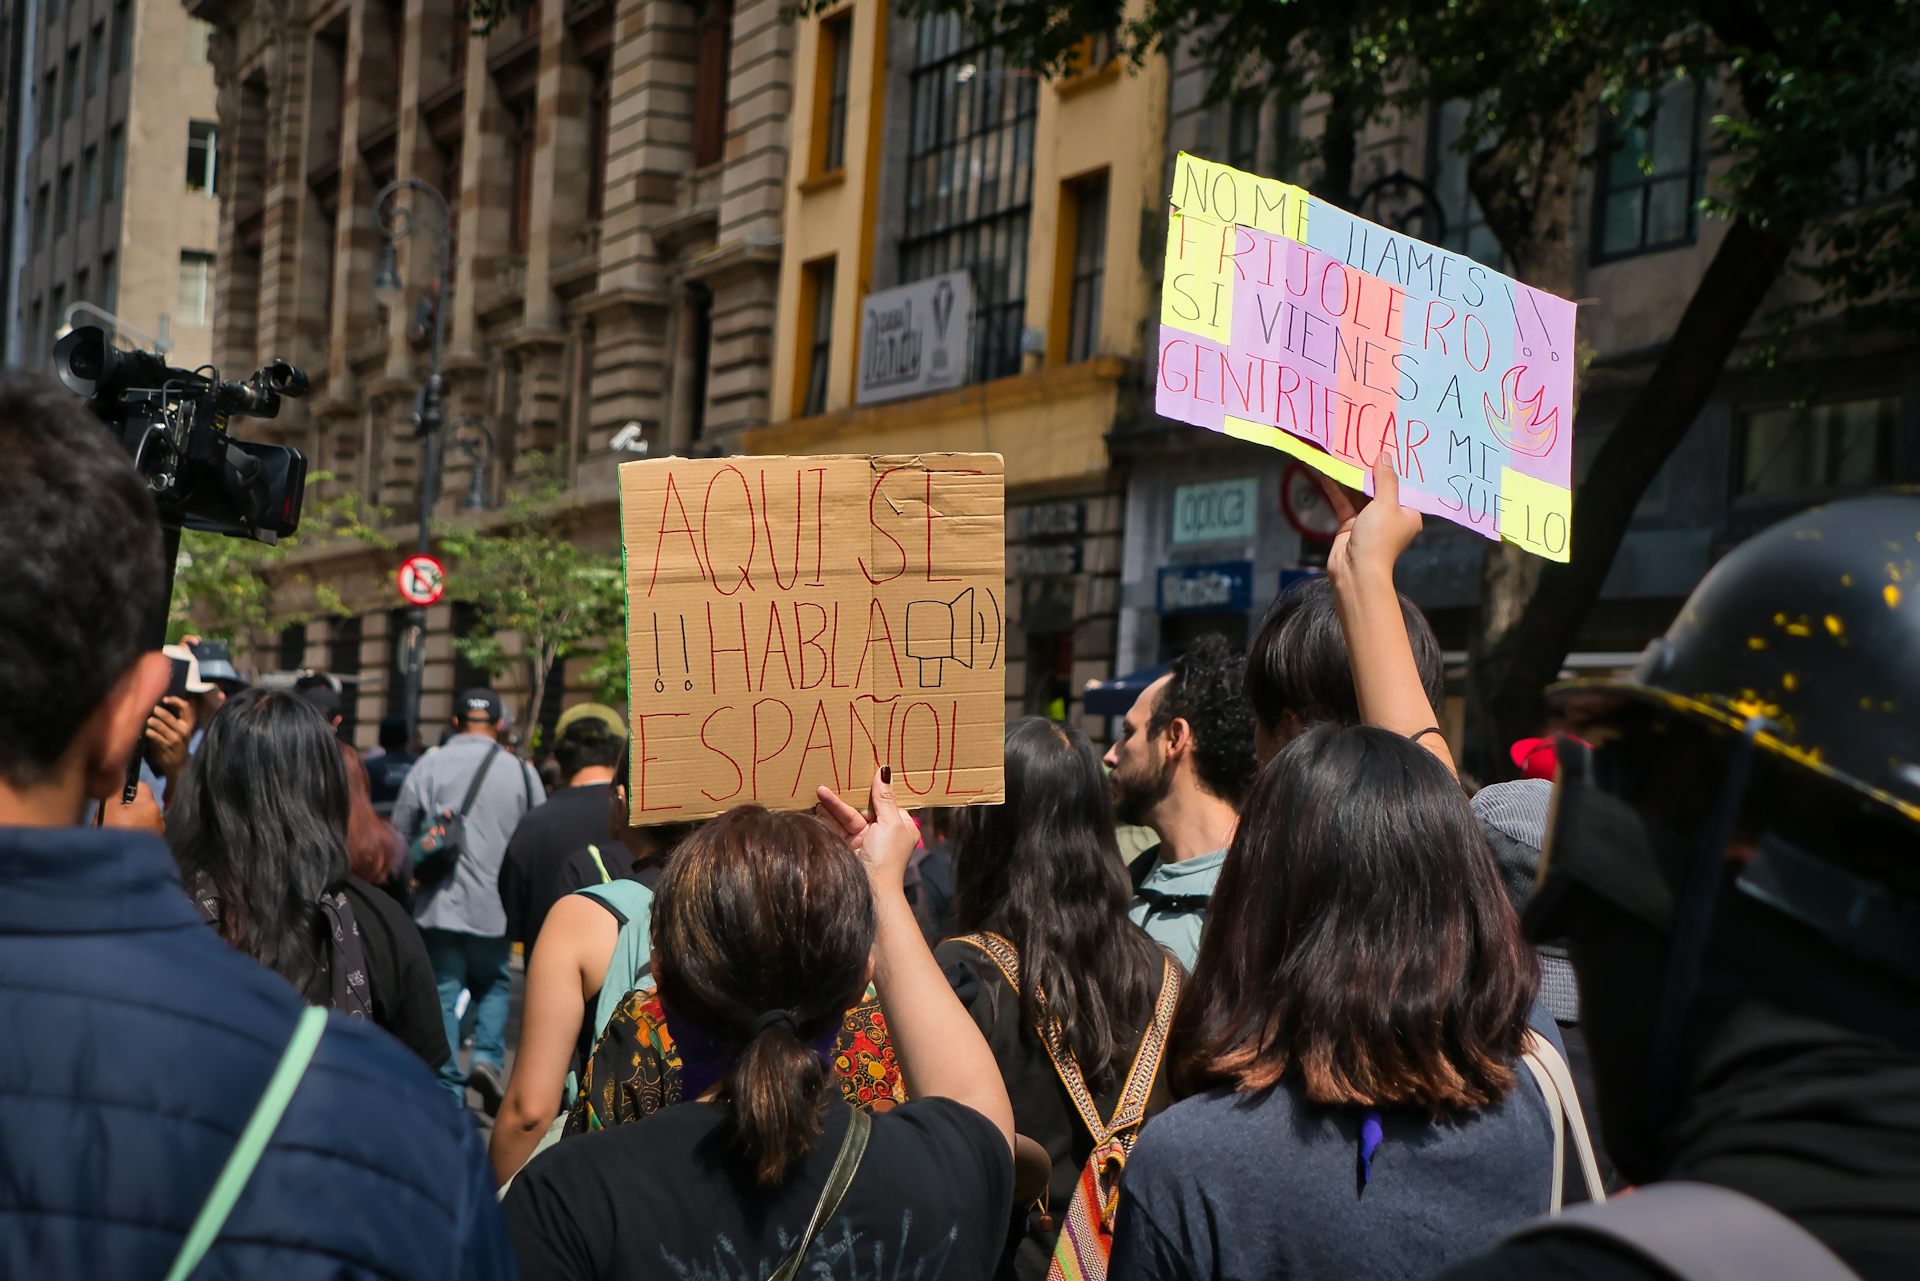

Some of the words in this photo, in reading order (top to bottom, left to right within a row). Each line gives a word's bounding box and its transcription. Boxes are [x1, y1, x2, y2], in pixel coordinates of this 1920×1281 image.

[1179, 214, 1491, 373] FRIJOLERO
[1182, 161, 1237, 223] NO
[1254, 184, 1323, 252] ME
[1346, 221, 1487, 308] LLAMES
[1161, 339, 1430, 484] GENTRIFICAR
[1448, 429, 1500, 484] MI
[1171, 273, 1225, 328] SI
[1256, 293, 1420, 401] VIENES
[1436, 374, 1464, 419] A
[647, 463, 828, 597] AQUI
[857, 466, 984, 586] SE
[1437, 474, 1567, 554] SUELO
[706, 597, 904, 695] HABLA
[639, 693, 985, 812] ESPAÑOL
